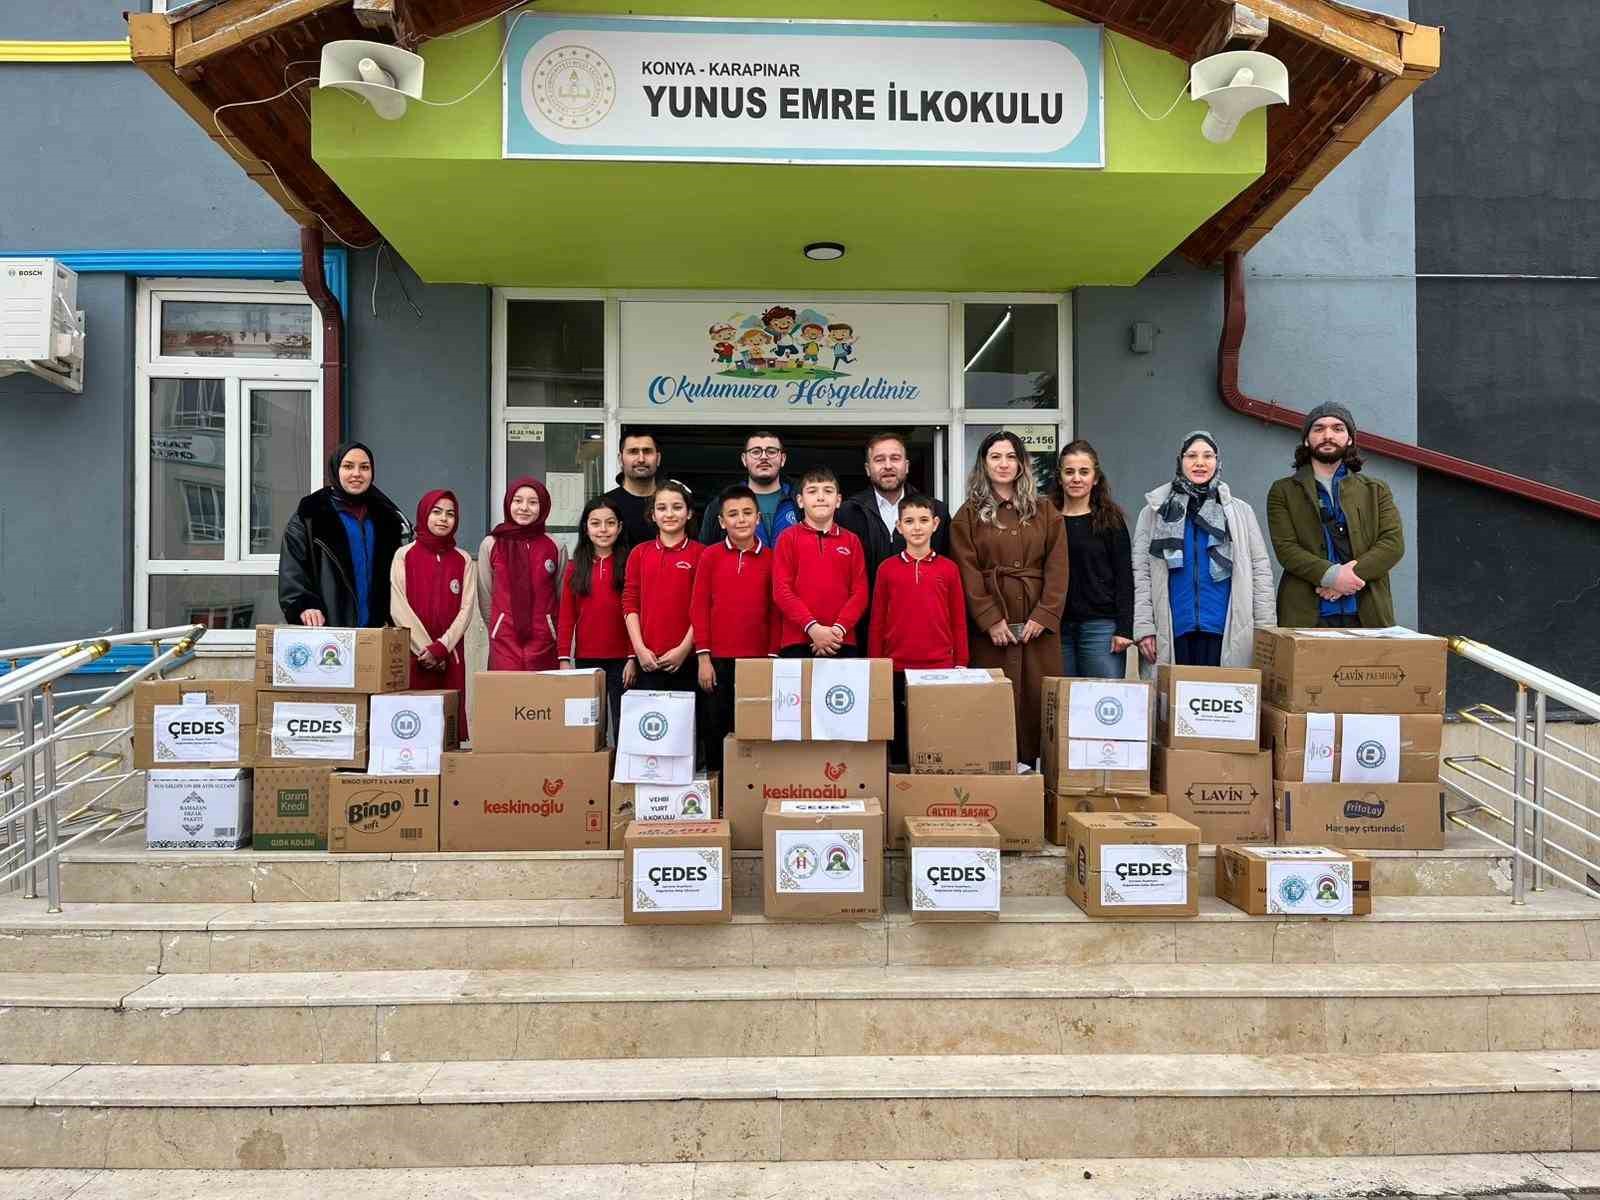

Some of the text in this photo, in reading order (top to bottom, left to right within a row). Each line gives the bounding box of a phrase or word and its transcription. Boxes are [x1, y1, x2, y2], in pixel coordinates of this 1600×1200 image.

[642, 61, 696, 76] KONYA
[709, 61, 800, 77] KARAPINAR
[642, 84, 767, 120] YUNUS
[780, 87, 876, 121] EMRE
[888, 81, 1064, 125] İLKOKULU
[648, 376, 921, 407] Okulumuza Hoşgeldiniz
[514, 706, 552, 720] Kent
[1189, 698, 1243, 715] ÇEDES
[168, 721, 225, 739] ÇEDES
[287, 719, 342, 736] ÇEDES
[1201, 786, 1243, 801] LAVİN
[349, 799, 402, 824] Bingo
[484, 799, 564, 817] keskinoğlu
[648, 866, 708, 886] ÇEDES
[927, 866, 986, 886] ÇEDES
[1115, 863, 1172, 881] ÇEDES
